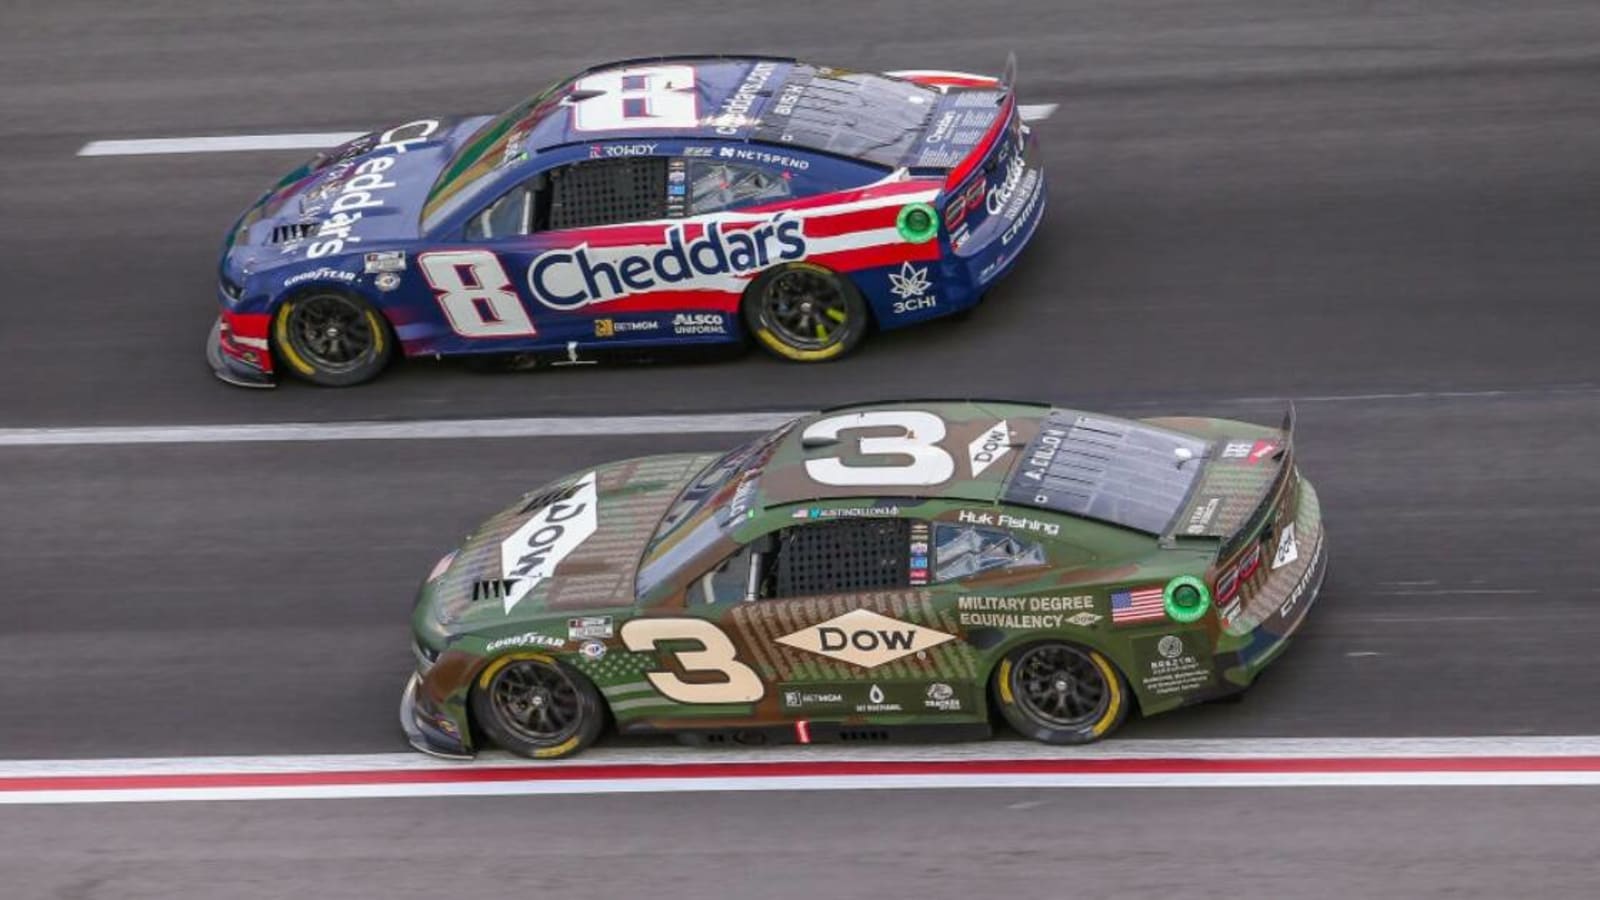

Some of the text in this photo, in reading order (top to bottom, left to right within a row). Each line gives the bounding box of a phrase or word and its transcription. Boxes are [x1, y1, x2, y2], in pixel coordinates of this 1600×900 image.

[576, 65, 697, 132] 8
[737, 149, 809, 171] NETSPEND
[532, 213, 806, 305] Cheddar's
[284, 267, 356, 287] GOODYEAR
[418, 250, 537, 337] 8
[893, 296, 936, 314] 3CHI
[672, 314, 723, 325] ALSCO
[803, 411, 955, 486] 3
[959, 510, 1060, 536] Huk Fishing
[958, 595, 1094, 611] MILITARY DEGREE
[960, 613, 1063, 629] EQUIVALENCY
[486, 632, 565, 651] GOODYEAR
[620, 618, 765, 704] 3
